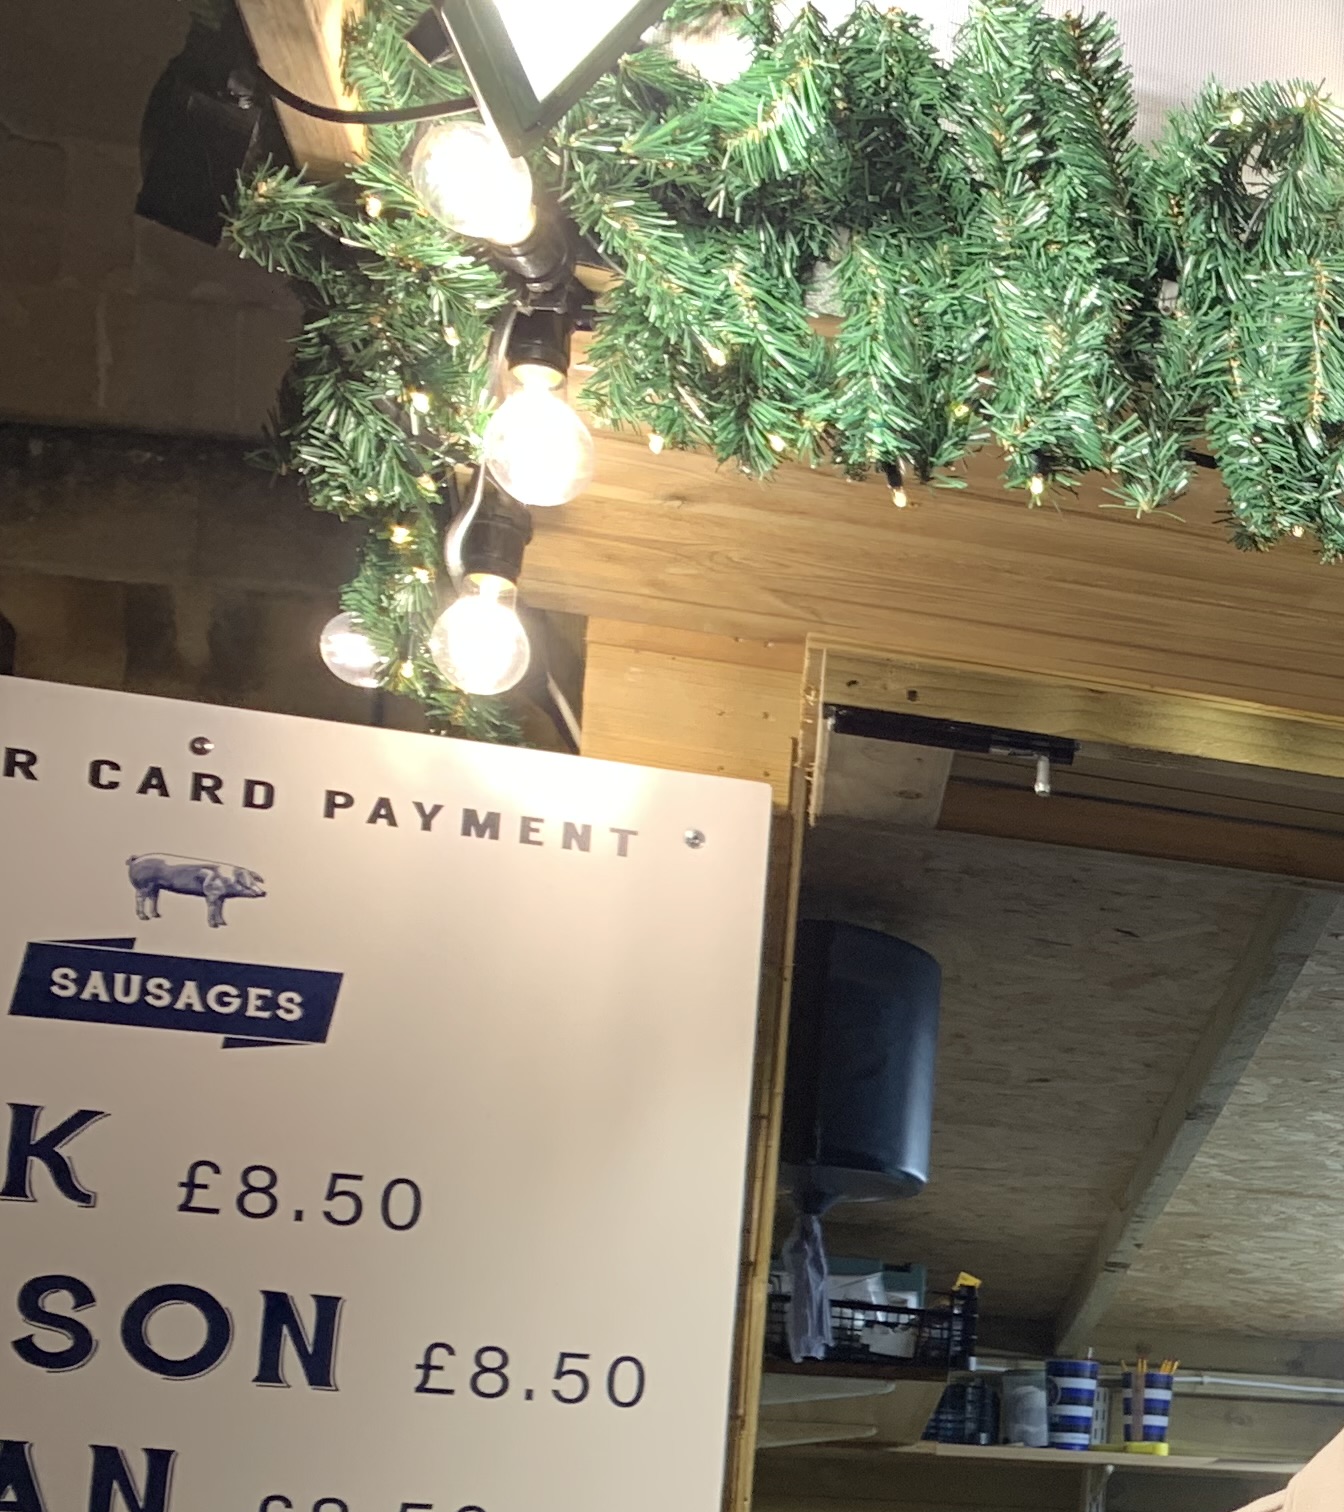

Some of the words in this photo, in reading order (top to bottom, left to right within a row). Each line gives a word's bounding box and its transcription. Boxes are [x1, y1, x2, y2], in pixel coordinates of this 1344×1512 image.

[88, 759, 275, 810] CARD
[323, 789, 639, 858] PAYMENT
[50, 967, 304, 1022] SAUSAGES
[0, 1103, 111, 1208] K
[178, 1160, 422, 1231] £8.50
[11, 1274, 350, 1391] SON
[414, 1342, 646, 1408] £8.50
